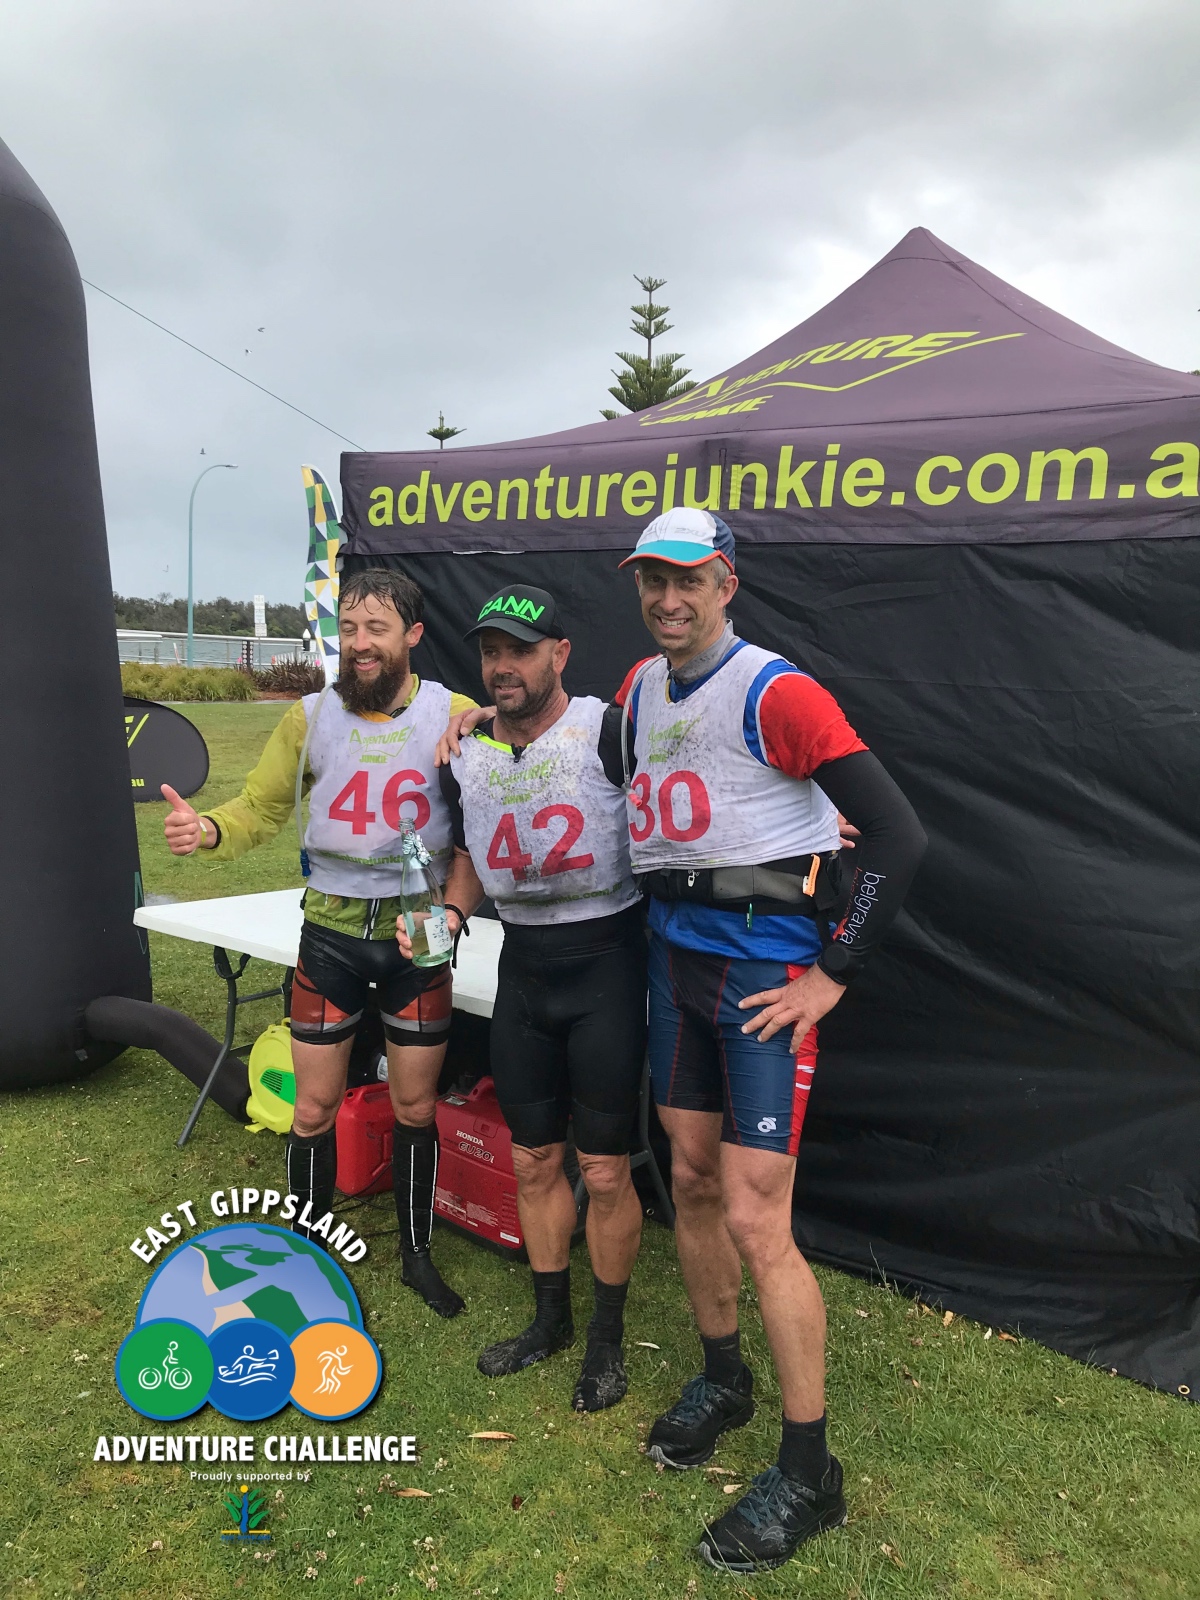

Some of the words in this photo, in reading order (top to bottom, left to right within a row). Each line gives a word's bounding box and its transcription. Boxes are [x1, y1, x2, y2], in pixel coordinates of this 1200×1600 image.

[660, 331, 981, 411] ADVENTURE
[640, 395, 774, 427] JUNKIE
[350, 726, 411, 745] ADVENTURE
[329, 769, 431, 835] 46
[629, 770, 711, 843] 30
[487, 804, 595, 881] 42
[840, 871, 887, 945] belgravia
[456, 1130, 484, 1146] HONDA
[459, 1141, 495, 1164] EU20i
